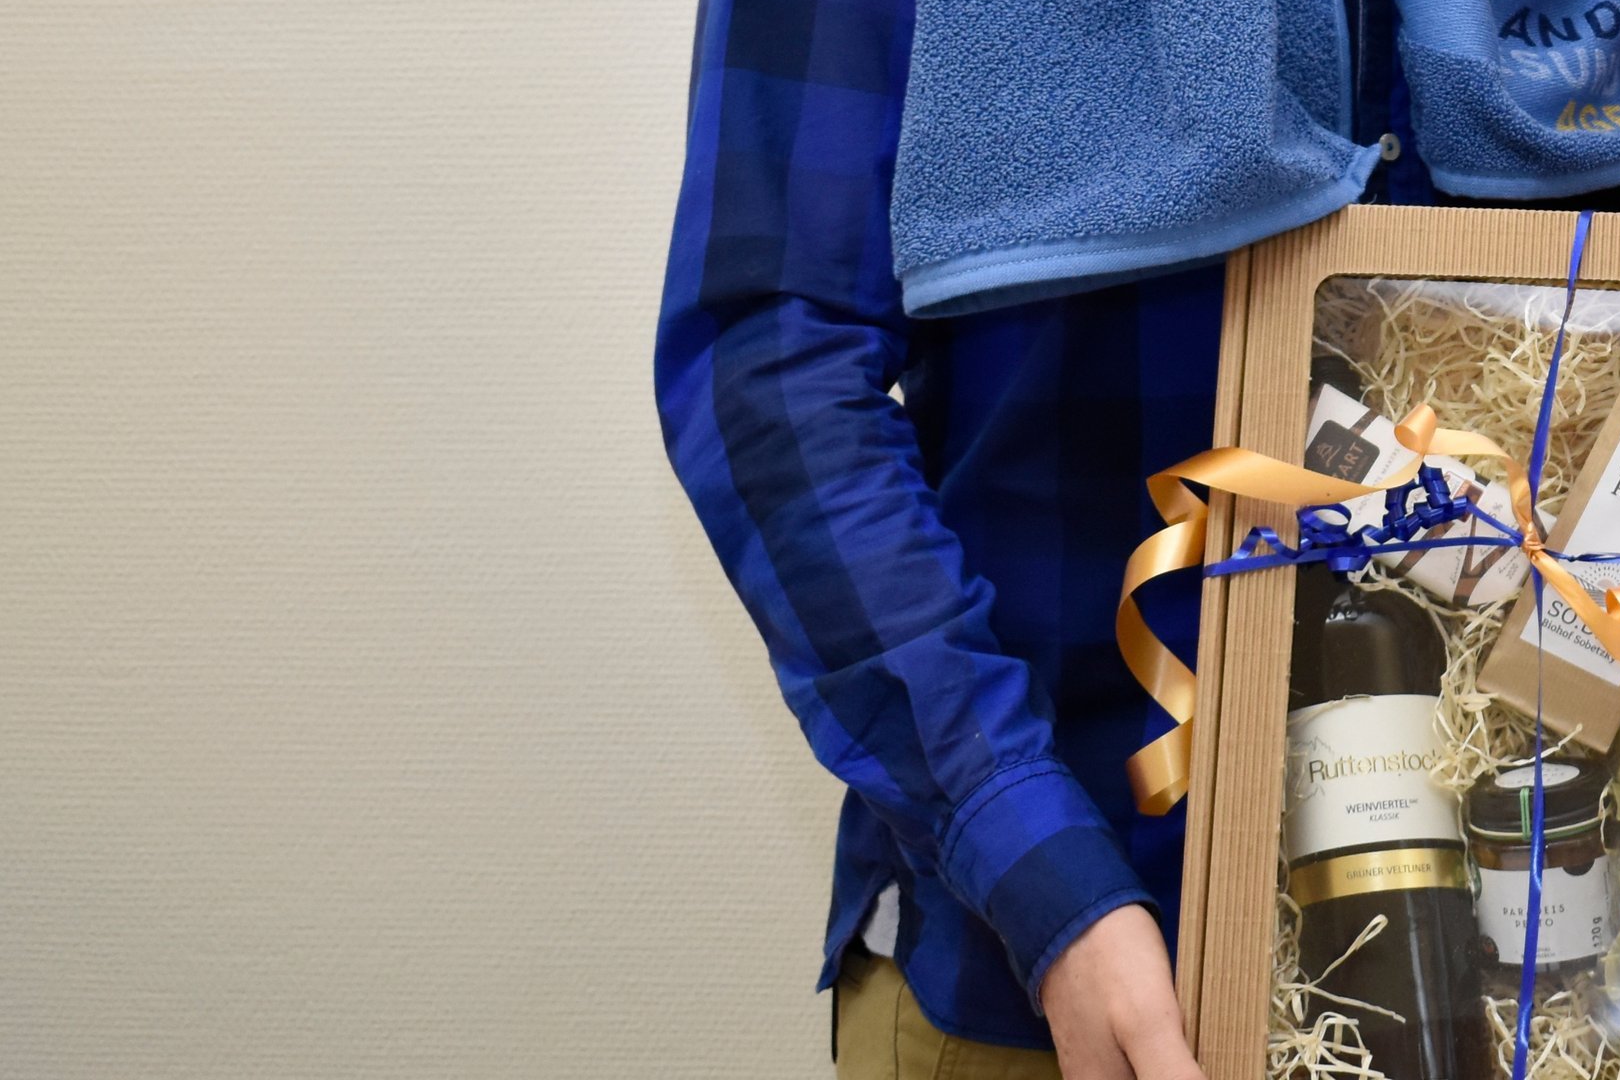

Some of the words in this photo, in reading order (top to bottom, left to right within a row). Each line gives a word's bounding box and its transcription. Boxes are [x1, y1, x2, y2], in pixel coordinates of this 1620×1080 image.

[1541, 617, 1575, 641] Biohof
[1346, 799, 1410, 814] WEINVIERTEL
[1503, 904, 1565, 916] PAREIS
